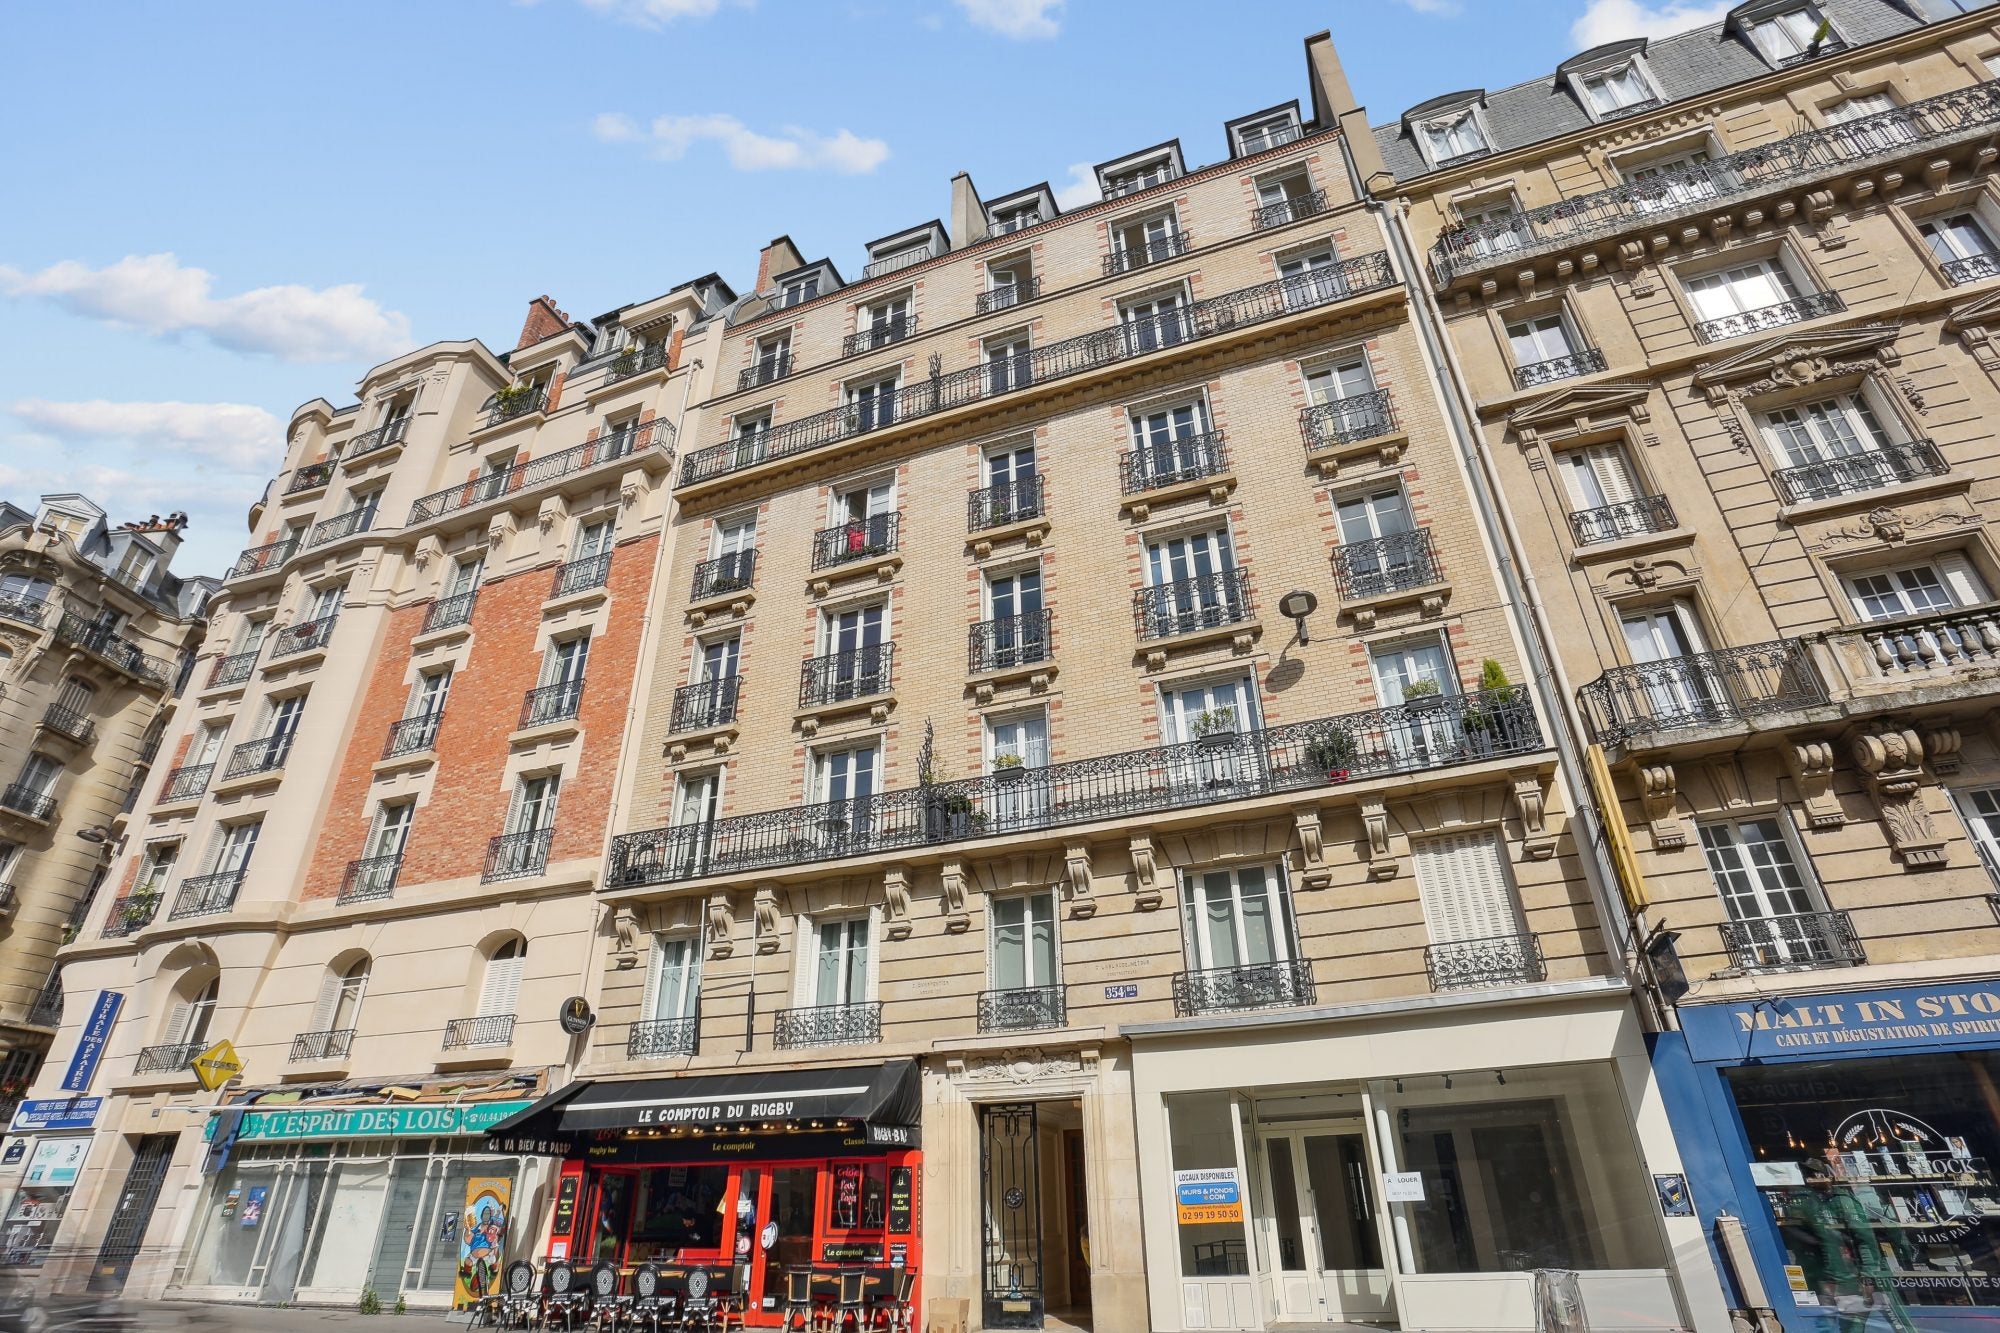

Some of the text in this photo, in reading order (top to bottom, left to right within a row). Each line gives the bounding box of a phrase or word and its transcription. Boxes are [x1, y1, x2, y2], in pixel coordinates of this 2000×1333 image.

[1106, 986, 1125, 998] 354
[92, 992, 116, 1036] CENTRALE
[1735, 992, 2000, 1032] MALT IN STO
[84, 1035, 103, 1043] DES
[1775, 1019, 2000, 1048] CAVE ET DÉGUSTATION DE SPIRI
[71, 1042, 96, 1088] AFFAIRES
[638, 1101, 794, 1123] LE COMPTOIR DU RUGBY
[269, 1111, 356, 1134] L'ESPRIT
[358, 1110, 400, 1130] DES
[404, 1109, 456, 1129] LOIS
[504, 1137, 514, 1152] VA
[537, 1140, 548, 1152] SE
[712, 1141, 756, 1152] Le comptoir
[1178, 1171, 1235, 1182] LOCAUX DISPONIBLES
[1397, 1176, 1418, 1184] LOUER
[1209, 1187, 1234, 1195] FONDS
[1182, 1209, 1239, 1220] 02 99 19 50 50
[1916, 1232, 1950, 1244] MAIS
[1949, 1223, 1972, 1240] PAS
[835, 1248, 865, 1258] comptoir
[1972, 1277, 1991, 1288] DE
